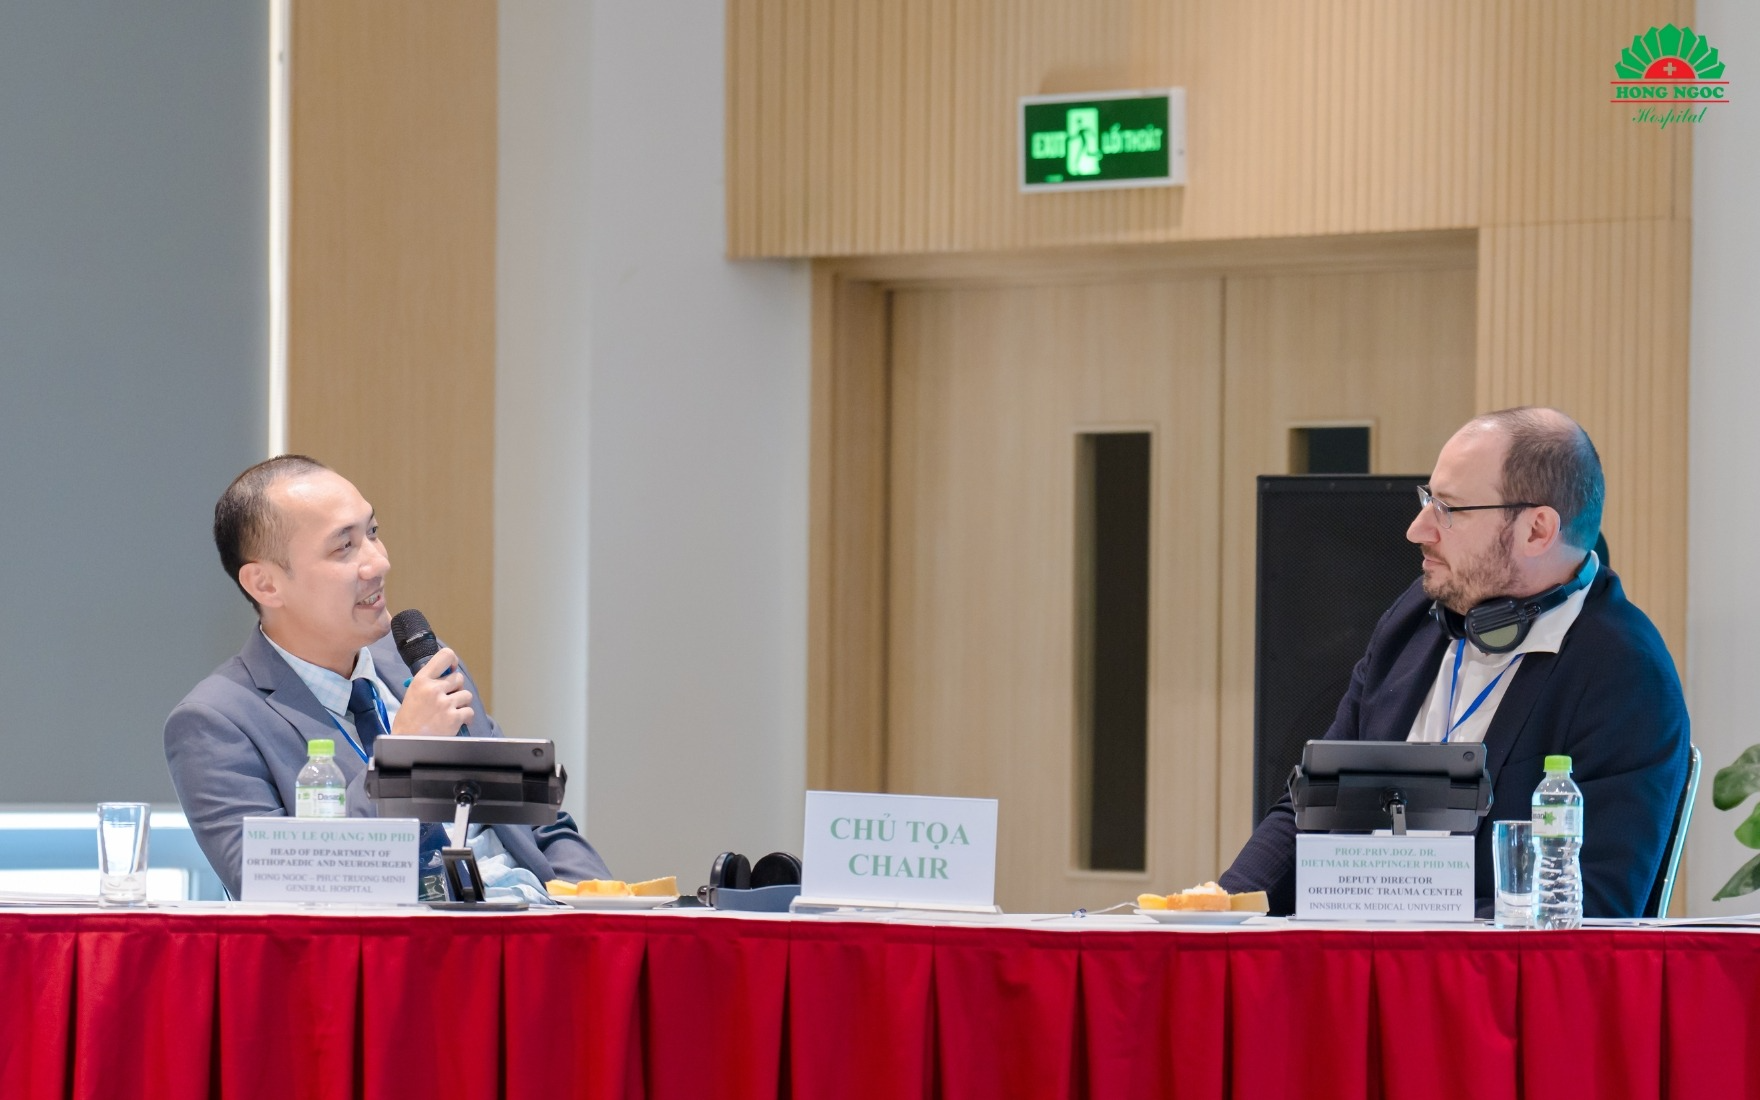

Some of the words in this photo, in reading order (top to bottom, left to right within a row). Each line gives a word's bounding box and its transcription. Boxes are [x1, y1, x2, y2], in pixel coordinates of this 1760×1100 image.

[247, 830, 269, 840] MR.
[273, 830, 297, 841] HUY
[302, 831, 317, 841] LE
[320, 831, 364, 842] QUANG
[368, 832, 388, 842] MD
[390, 832, 415, 843] PHD
[830, 813, 896, 842] CHỦ
[906, 821, 970, 850] TỌA
[270, 848, 297, 856] HEAD
[298, 848, 311, 856] OF
[313, 848, 376, 858] DEPARTMENT
[378, 849, 391, 858] OF
[1420, 848, 1437, 857] DR.
[246, 858, 313, 867] ORTHOPAEDIC
[317, 859, 336, 868] AND
[338, 859, 413, 869] NEUROSURGERY
[848, 853, 949, 880] CHAIR
[1301, 859, 1350, 868] DIETMAR
[1352, 859, 1420, 869] KRAPPINGER
[1423, 860, 1445, 869] PHD
[1448, 860, 1470, 869] MBA
[254, 873, 280, 881] HONG
[282, 873, 307, 882] NGOC
[316, 874, 340, 882] PHUC
[343, 874, 379, 883] TRUONG
[382, 875, 406, 883] MINH
[1338, 875, 1378, 884] DEPUTY
[1380, 876, 1433, 885] DIRECTOR
[286, 884, 328, 893] GENERAL
[330, 885, 374, 894] HOSPITAL
[1308, 887, 1374, 895] ORTHOPEDIC
[1376, 887, 1420, 896] TRAUMA
[1422, 888, 1463, 897] CENTER
[1309, 902, 1362, 911] INNSBRUCK
[1363, 902, 1405, 911] MEDICAL
[1407, 903, 1462, 912] UNIVERSITY
